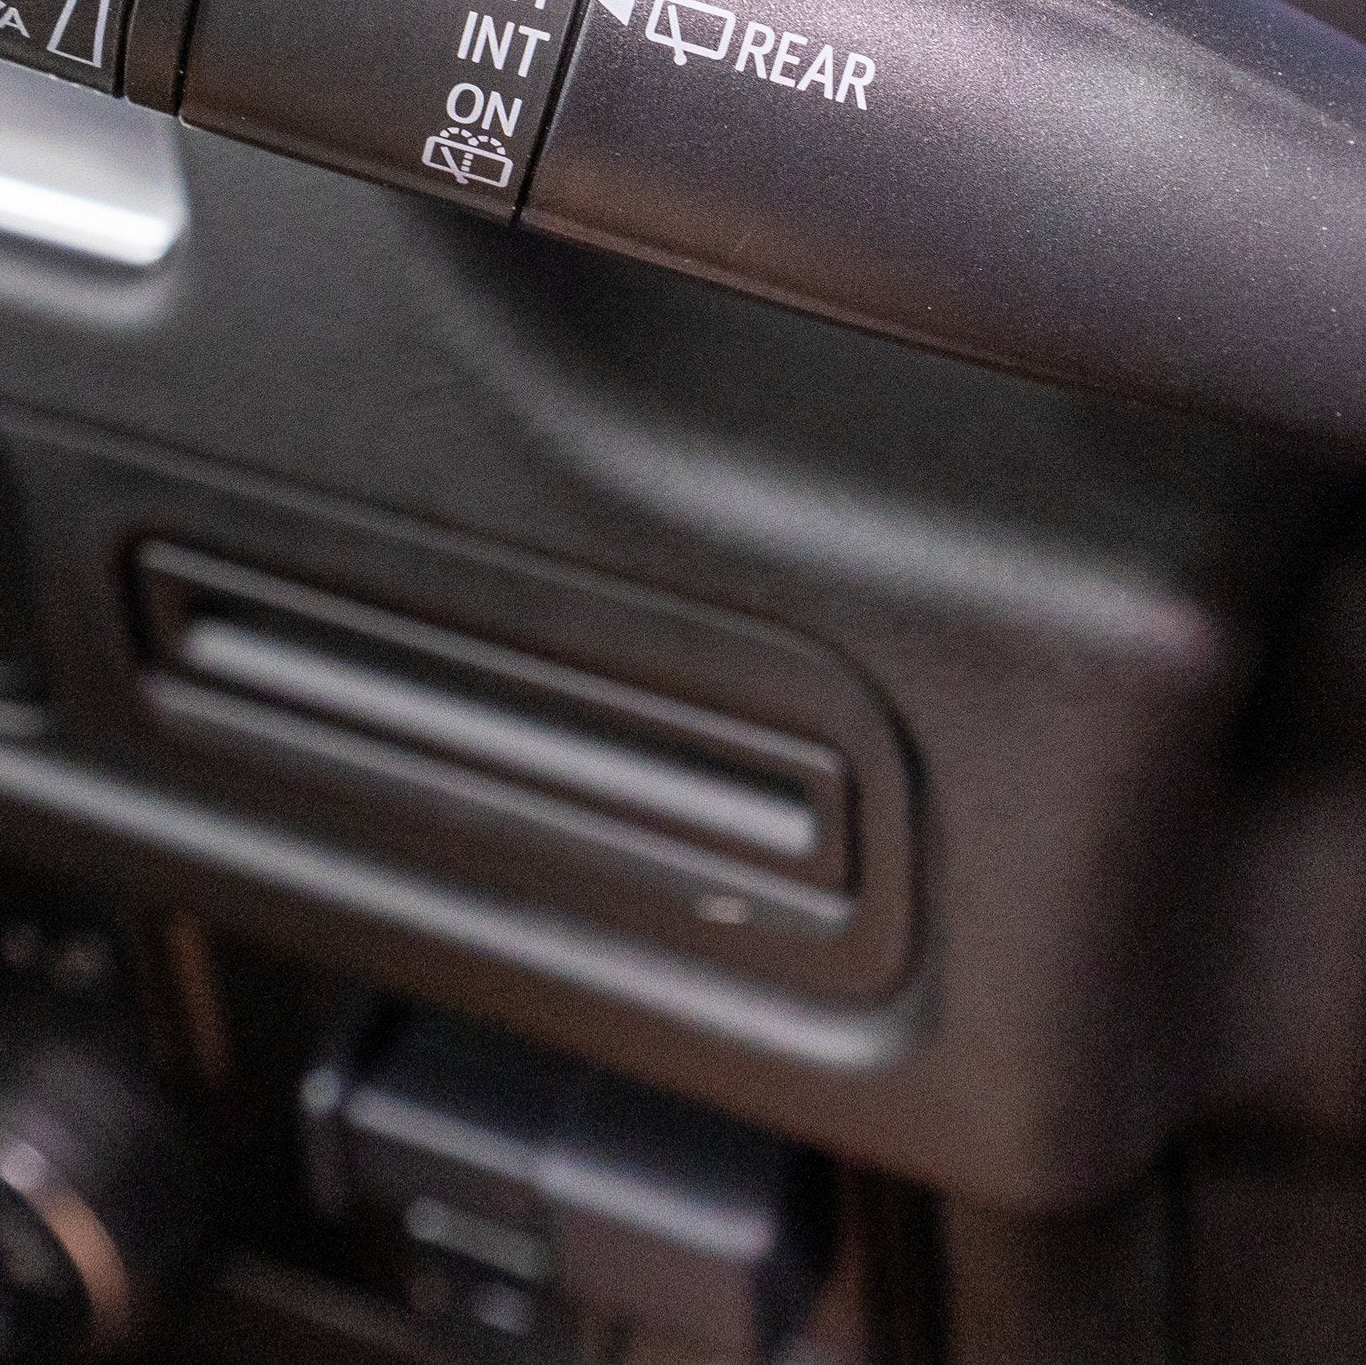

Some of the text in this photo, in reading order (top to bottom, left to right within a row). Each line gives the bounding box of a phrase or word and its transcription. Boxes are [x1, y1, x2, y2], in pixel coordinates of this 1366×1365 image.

[457, 10, 552, 78] INT
[734, 20, 876, 111] REAR
[446, 82, 523, 138] ON
